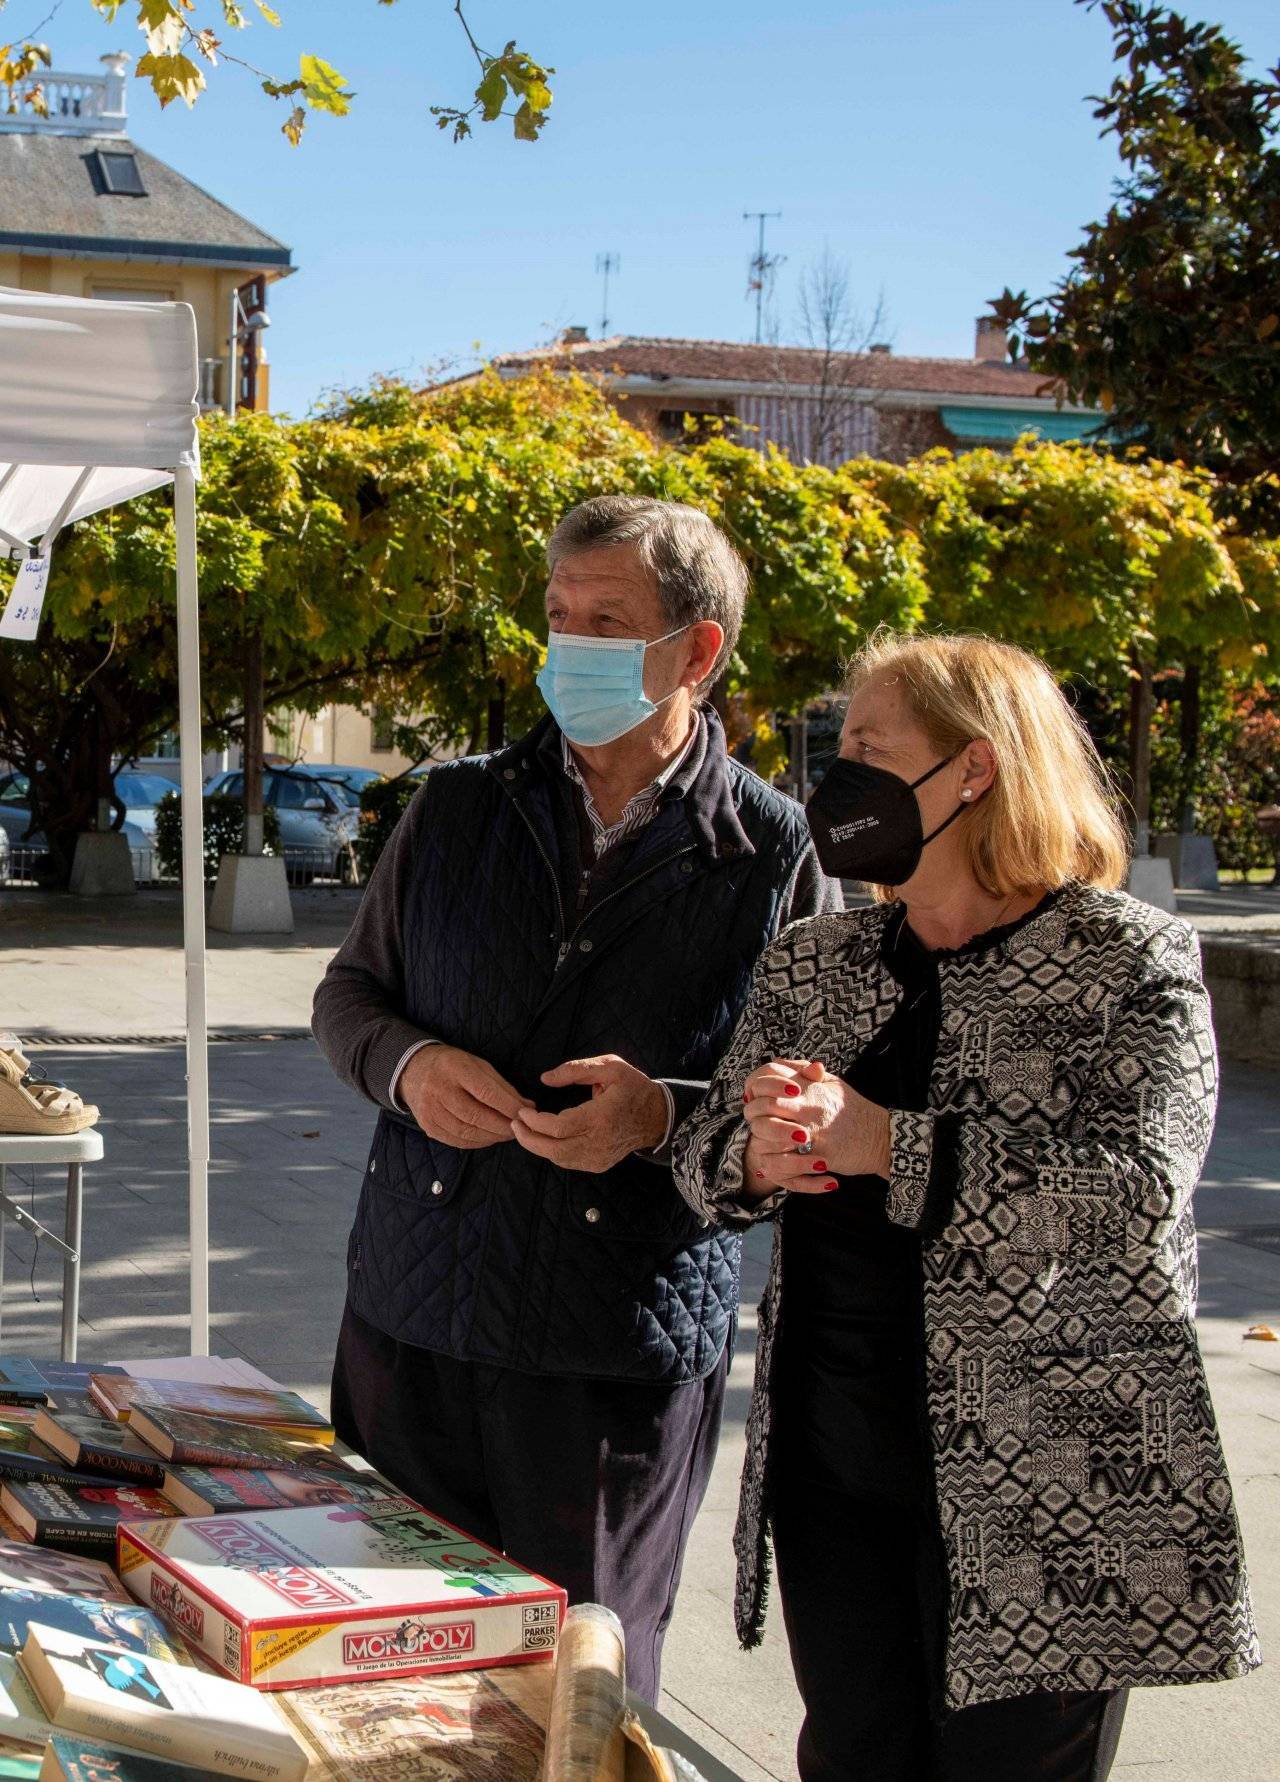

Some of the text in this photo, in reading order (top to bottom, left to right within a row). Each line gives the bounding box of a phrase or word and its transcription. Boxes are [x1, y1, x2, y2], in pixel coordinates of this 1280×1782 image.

[84, 1453, 155, 1475] ROBIN COOK
[6, 1467, 36, 1480] ROBIN
[153, 1577, 203, 1632] MONOPOLY
[288, 1629, 307, 1645] reglas
[524, 1626, 556, 1639] PARKER
[347, 1627, 470, 1662] MONOPOLY
[254, 1661, 268, 1673] para
[270, 1655, 277, 1664] un
[363, 1662, 378, 1671] Juego
[379, 1661, 386, 1669] de
[395, 1657, 428, 1668] Operaciones
[213, 1750, 249, 1772] bullrich
